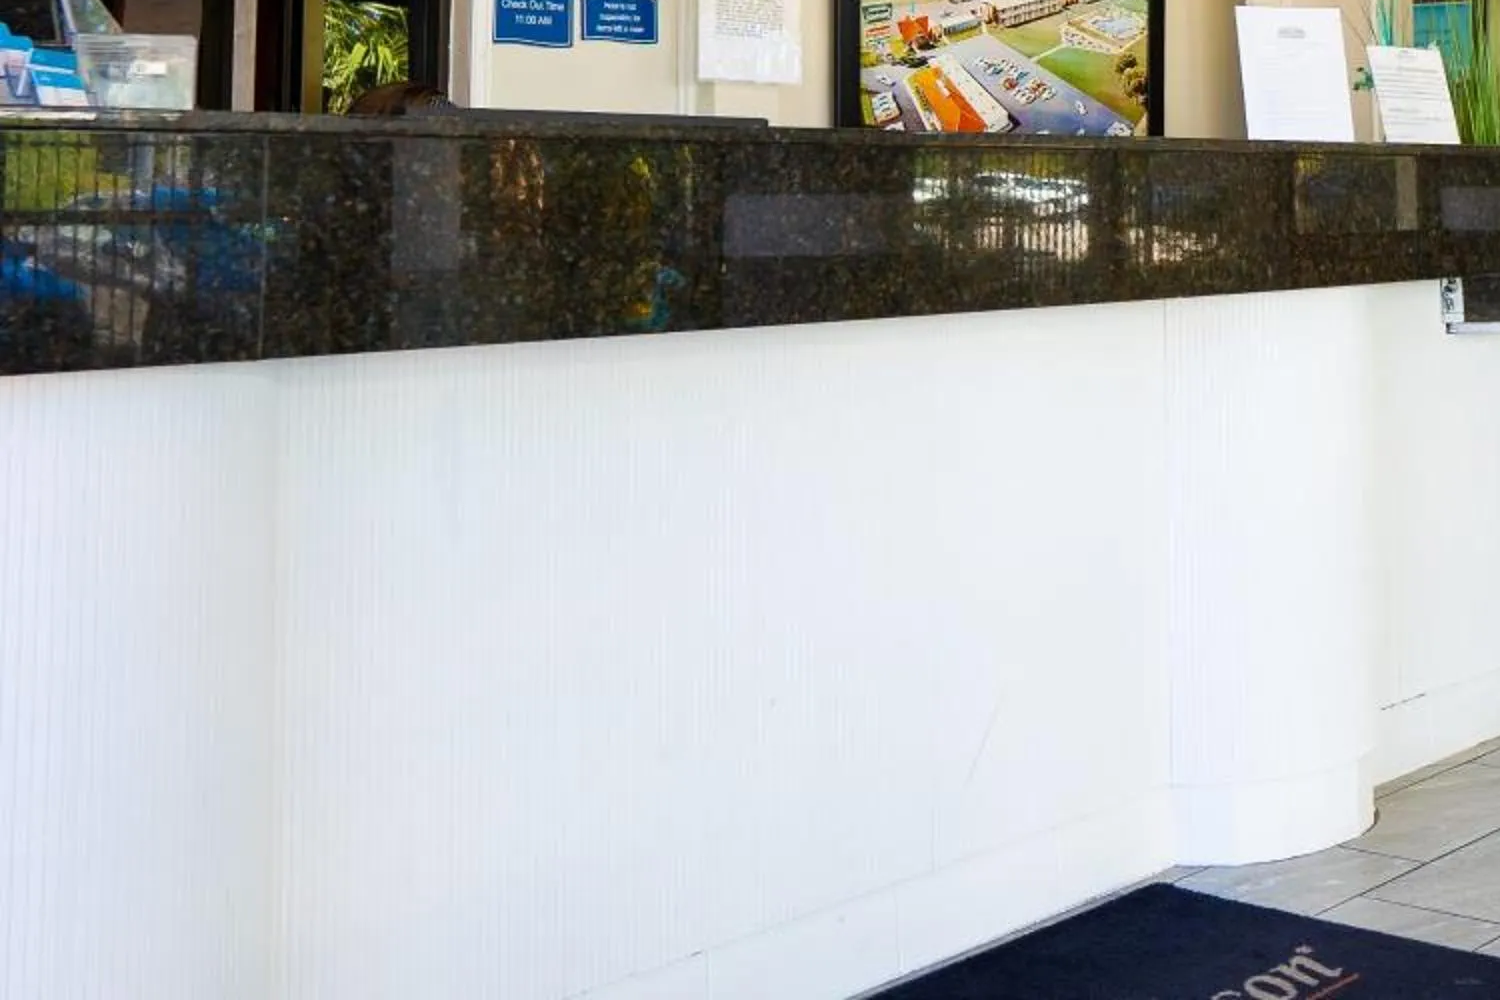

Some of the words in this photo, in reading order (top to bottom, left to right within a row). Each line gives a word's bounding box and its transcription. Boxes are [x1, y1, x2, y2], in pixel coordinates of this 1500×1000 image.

[529, 0, 544, 10] Out
[546, 1, 565, 11] Time
[537, 15, 552, 25] AM
